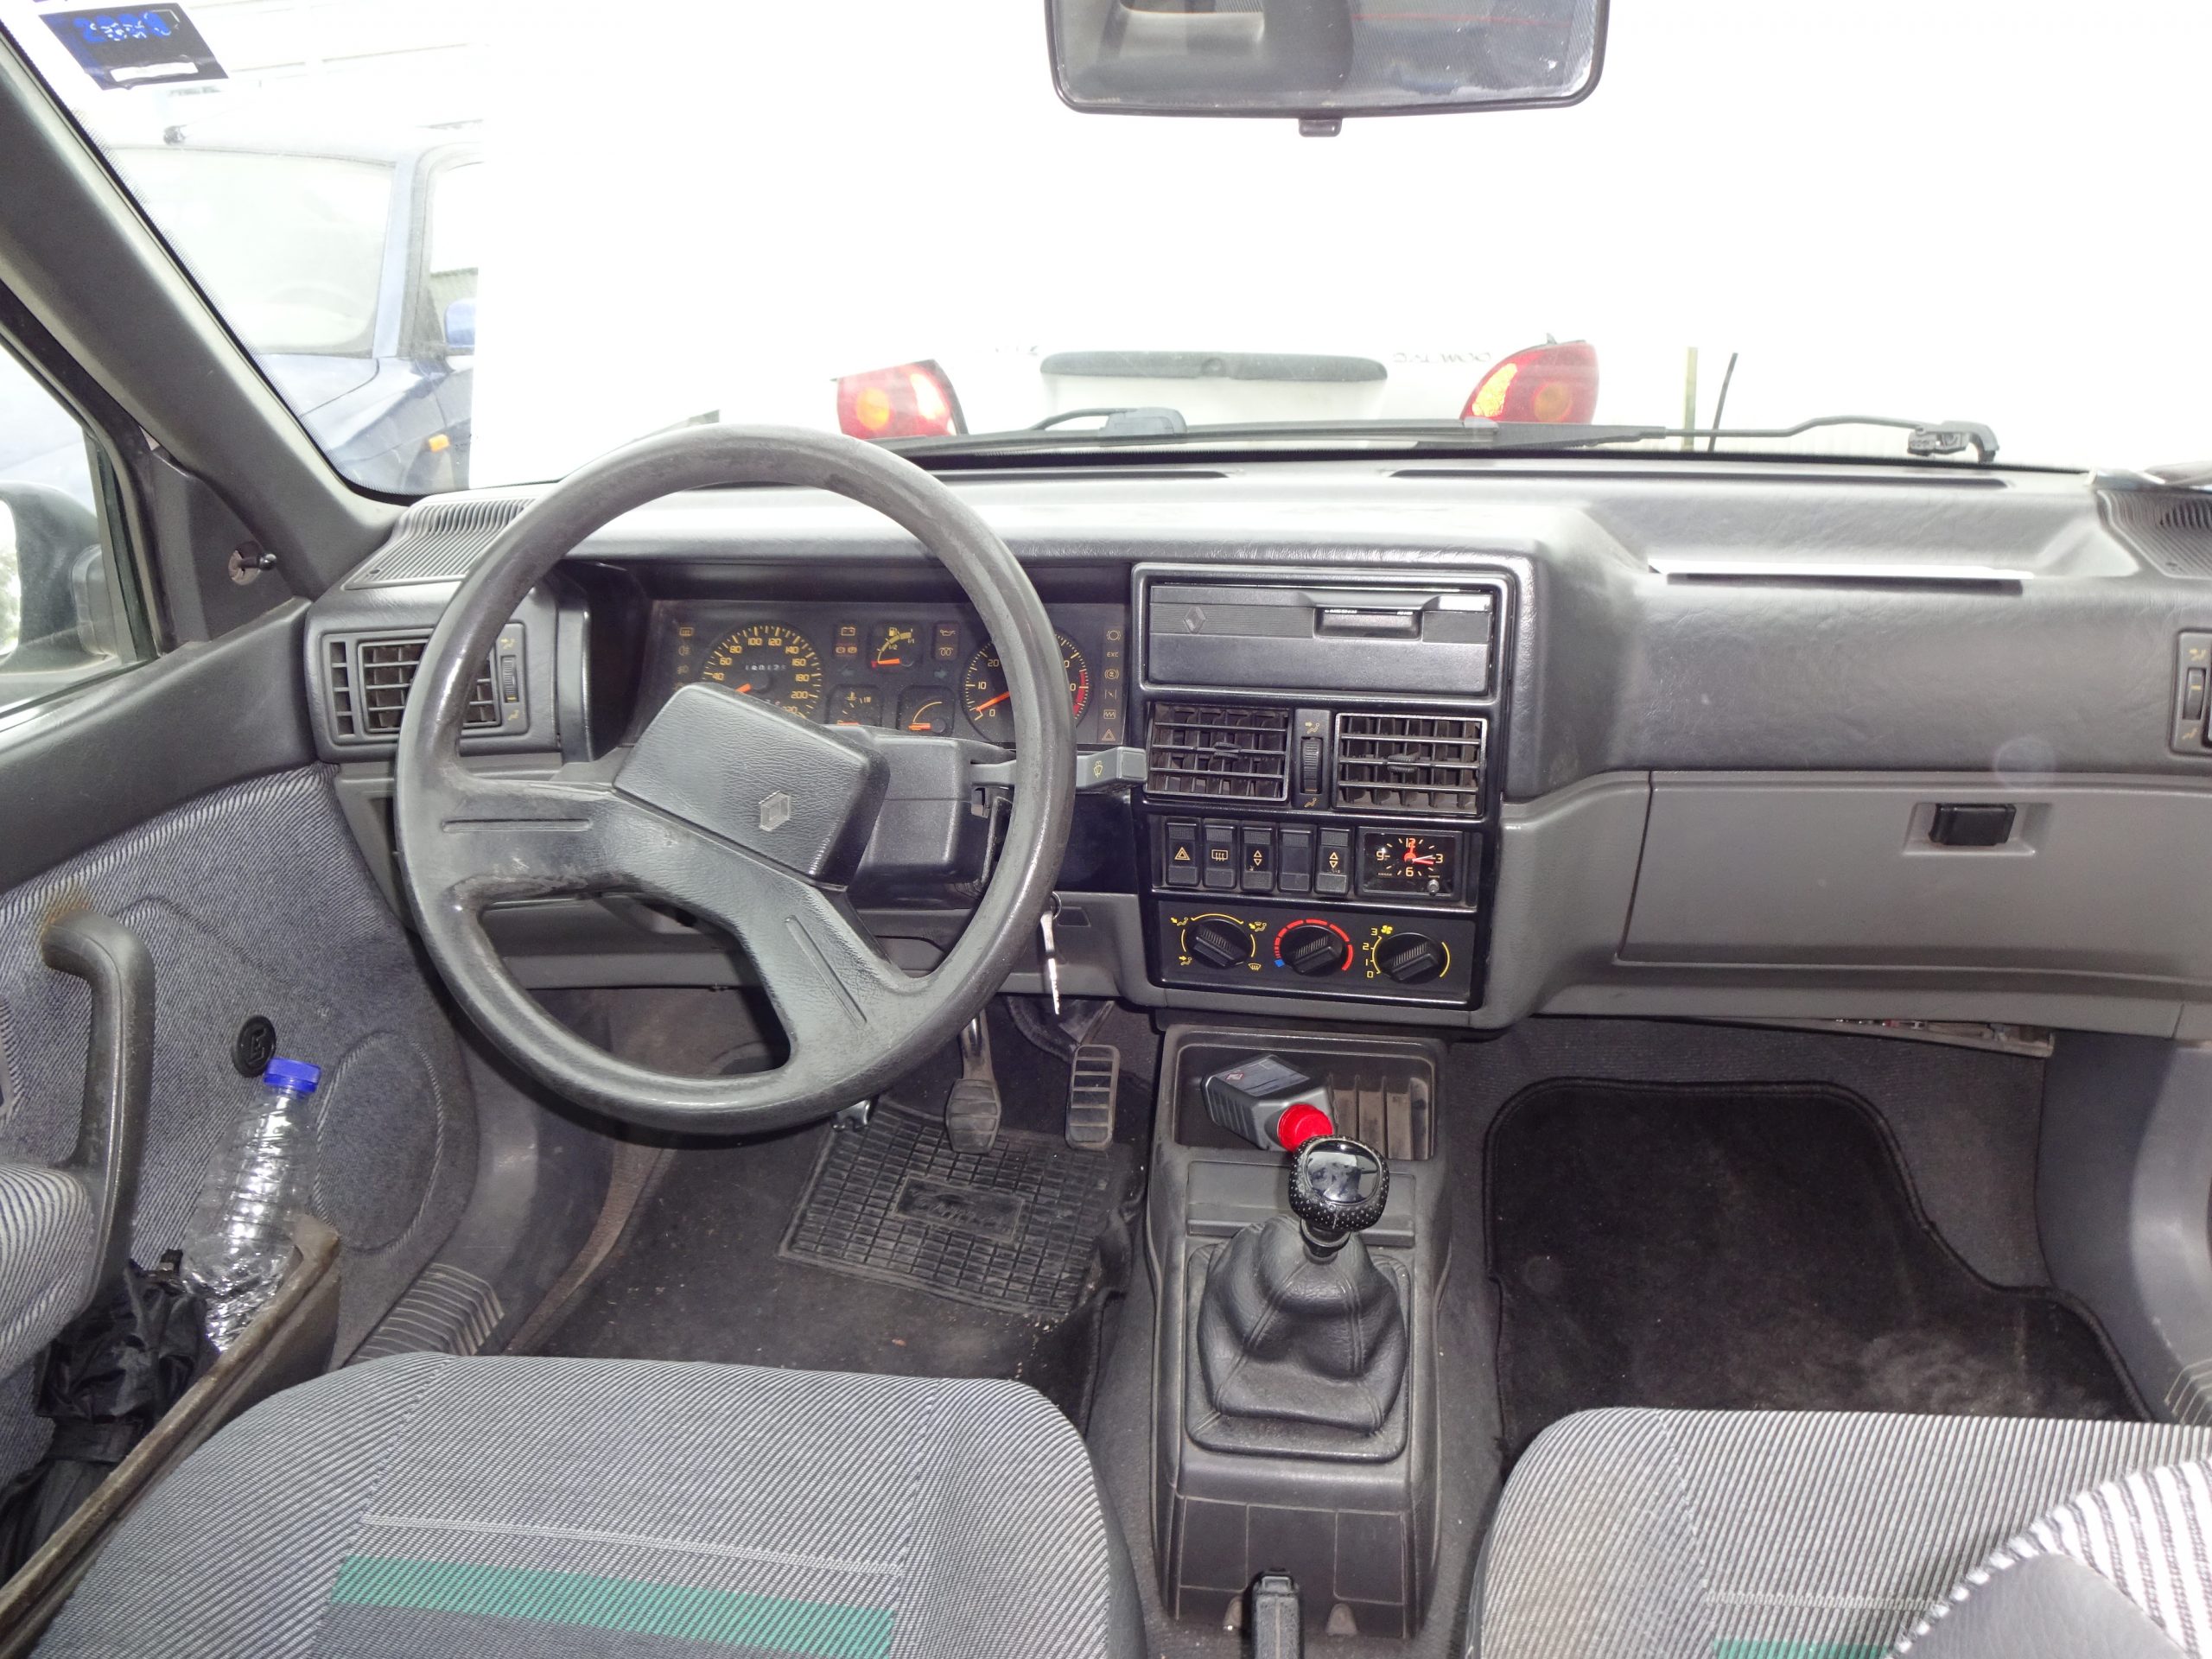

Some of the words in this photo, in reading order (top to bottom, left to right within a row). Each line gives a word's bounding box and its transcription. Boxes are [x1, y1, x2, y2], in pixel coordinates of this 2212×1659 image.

[747, 638, 763, 646] 100
[768, 638, 782, 646] 120
[729, 645, 742, 654] 80
[785, 645, 799, 654] 140
[720, 657, 732, 665] 60
[791, 658, 806, 666] 160
[987, 658, 1000, 667] 20
[712, 672, 725, 681] 40
[795, 673, 810, 682] 180
[977, 681, 987, 690] 10
[791, 690, 809, 699] 200
[988, 709, 995, 717] 0
[1405, 837, 1416, 849] 12
[1376, 850, 1384, 861] 9
[1435, 853, 1444, 863] 3
[1405, 867, 1414, 877] 6
[1370, 927, 1378, 936] 3
[1362, 942, 1370, 950] 2
